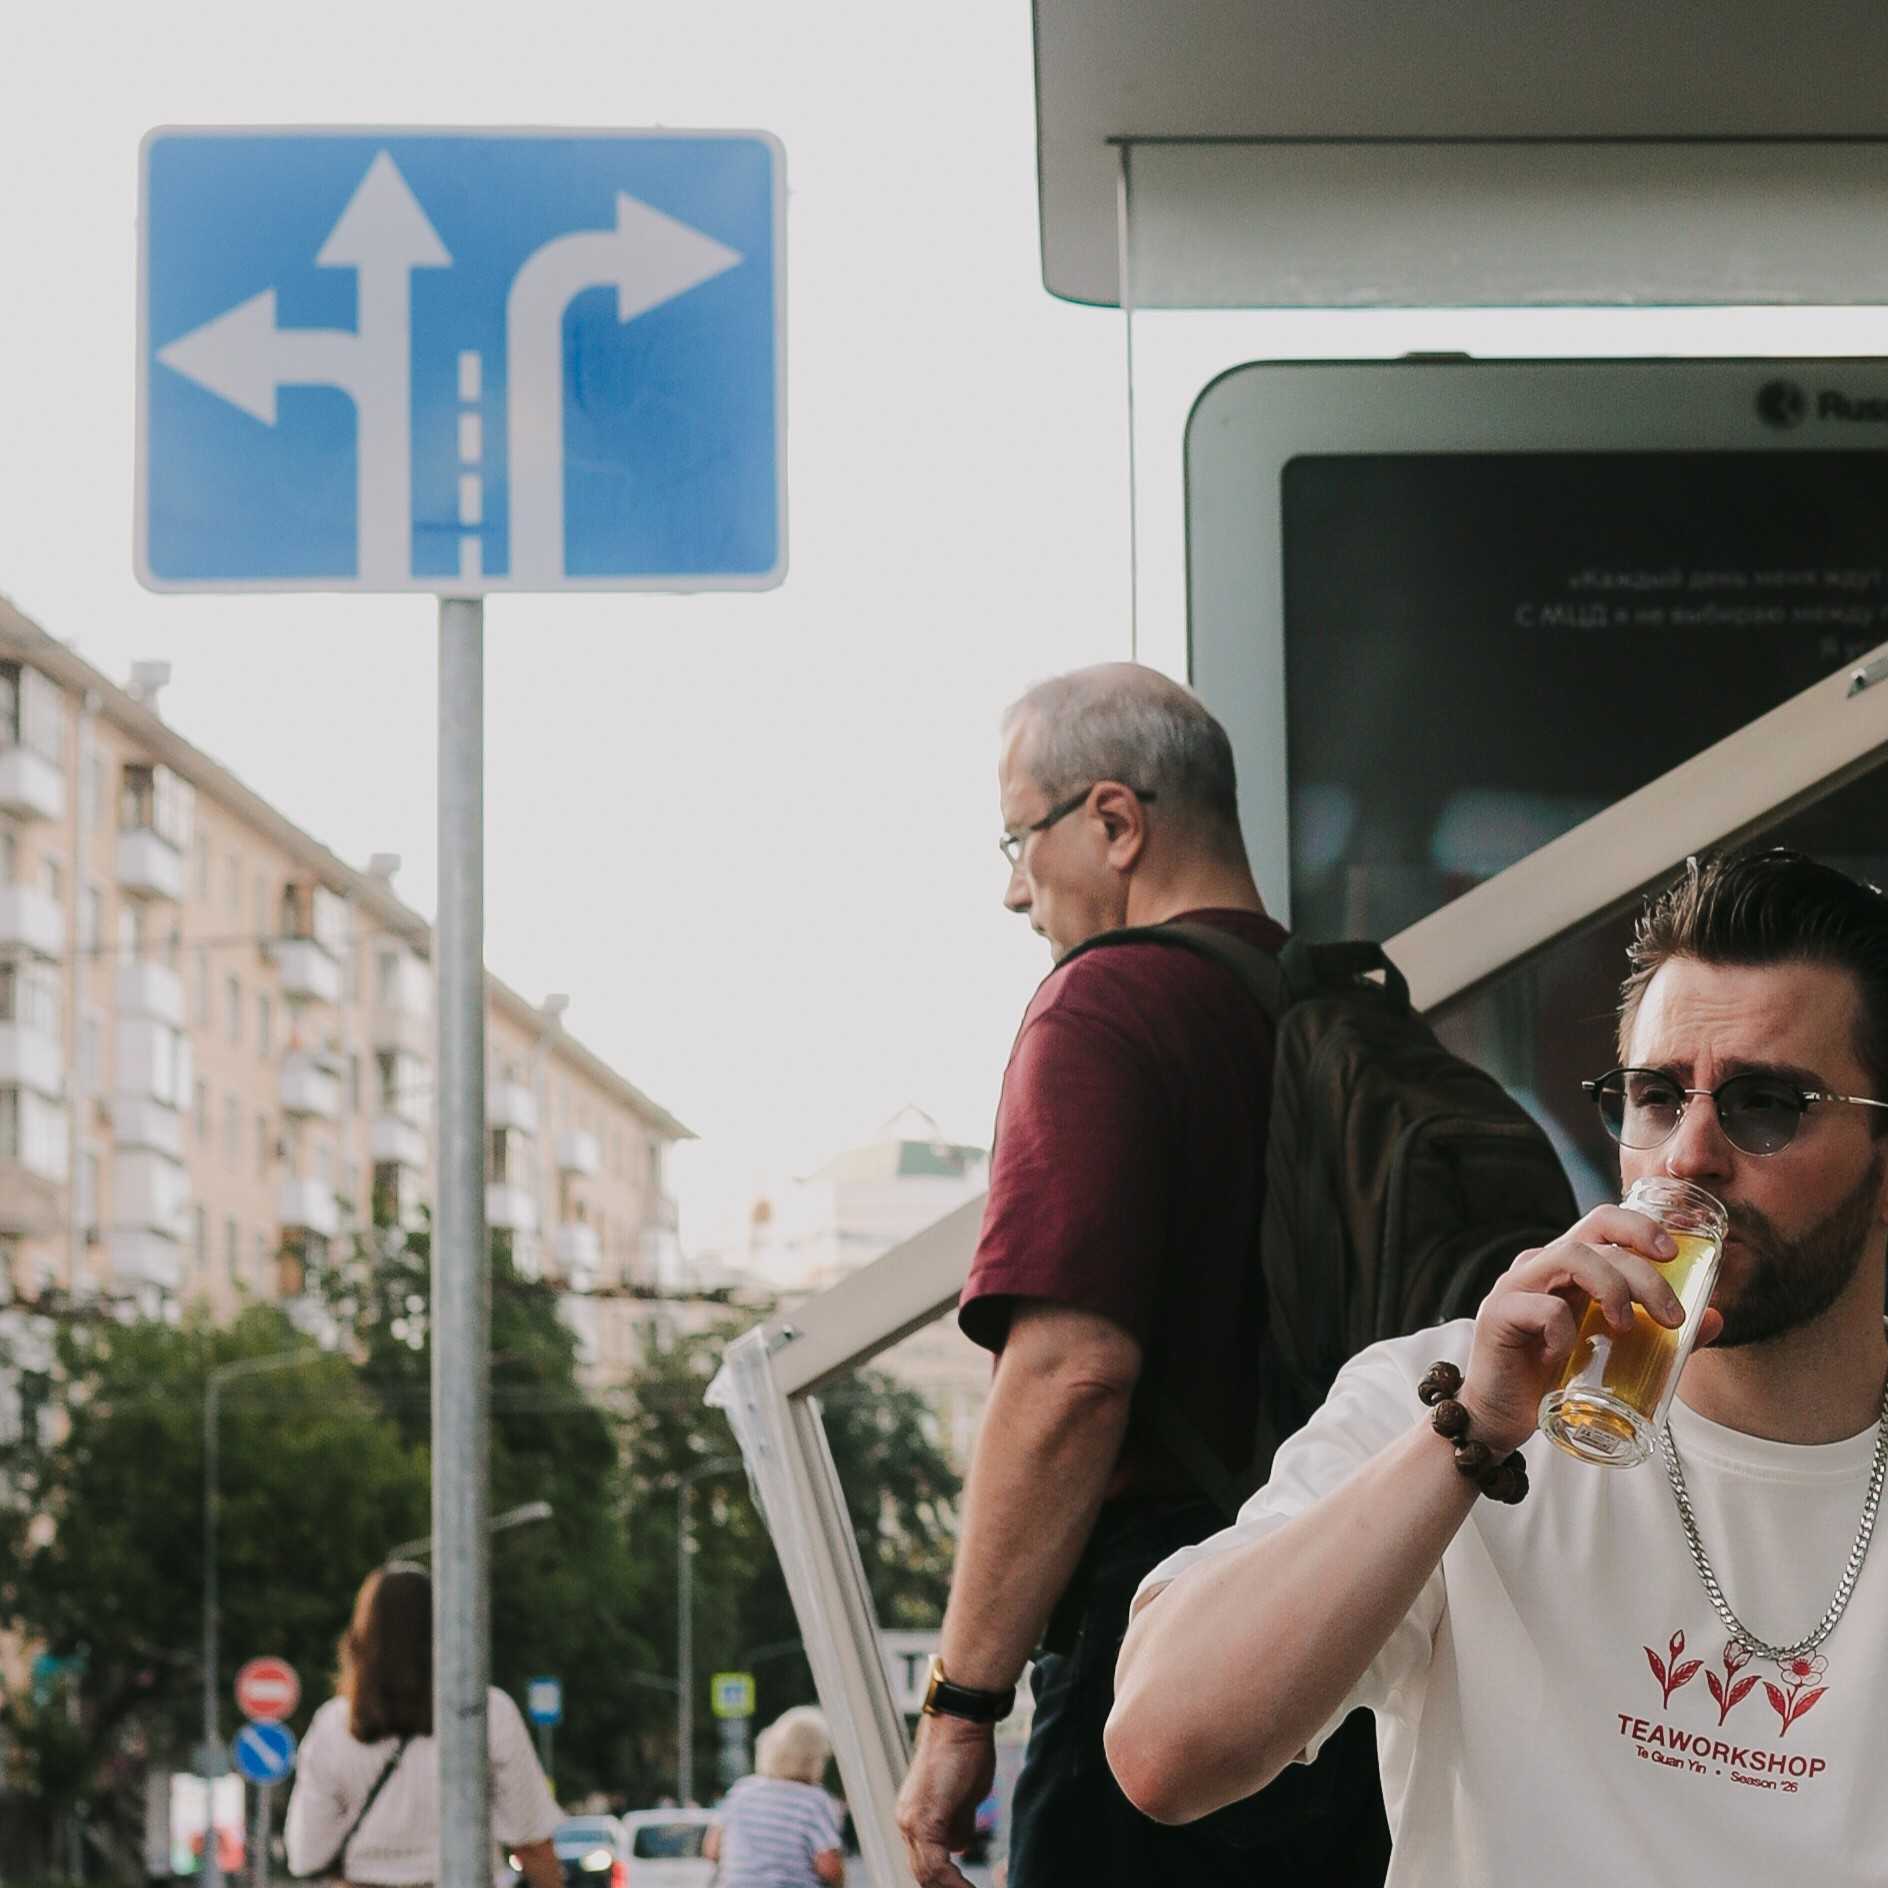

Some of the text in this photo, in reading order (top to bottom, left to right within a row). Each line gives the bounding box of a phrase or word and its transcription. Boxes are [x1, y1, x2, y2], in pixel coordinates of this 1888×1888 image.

[1617, 1713, 1827, 1779] TEAWORKSHOP
[1636, 1744, 1649, 1759] Te
[1730, 1770, 1777, 1790] Season
